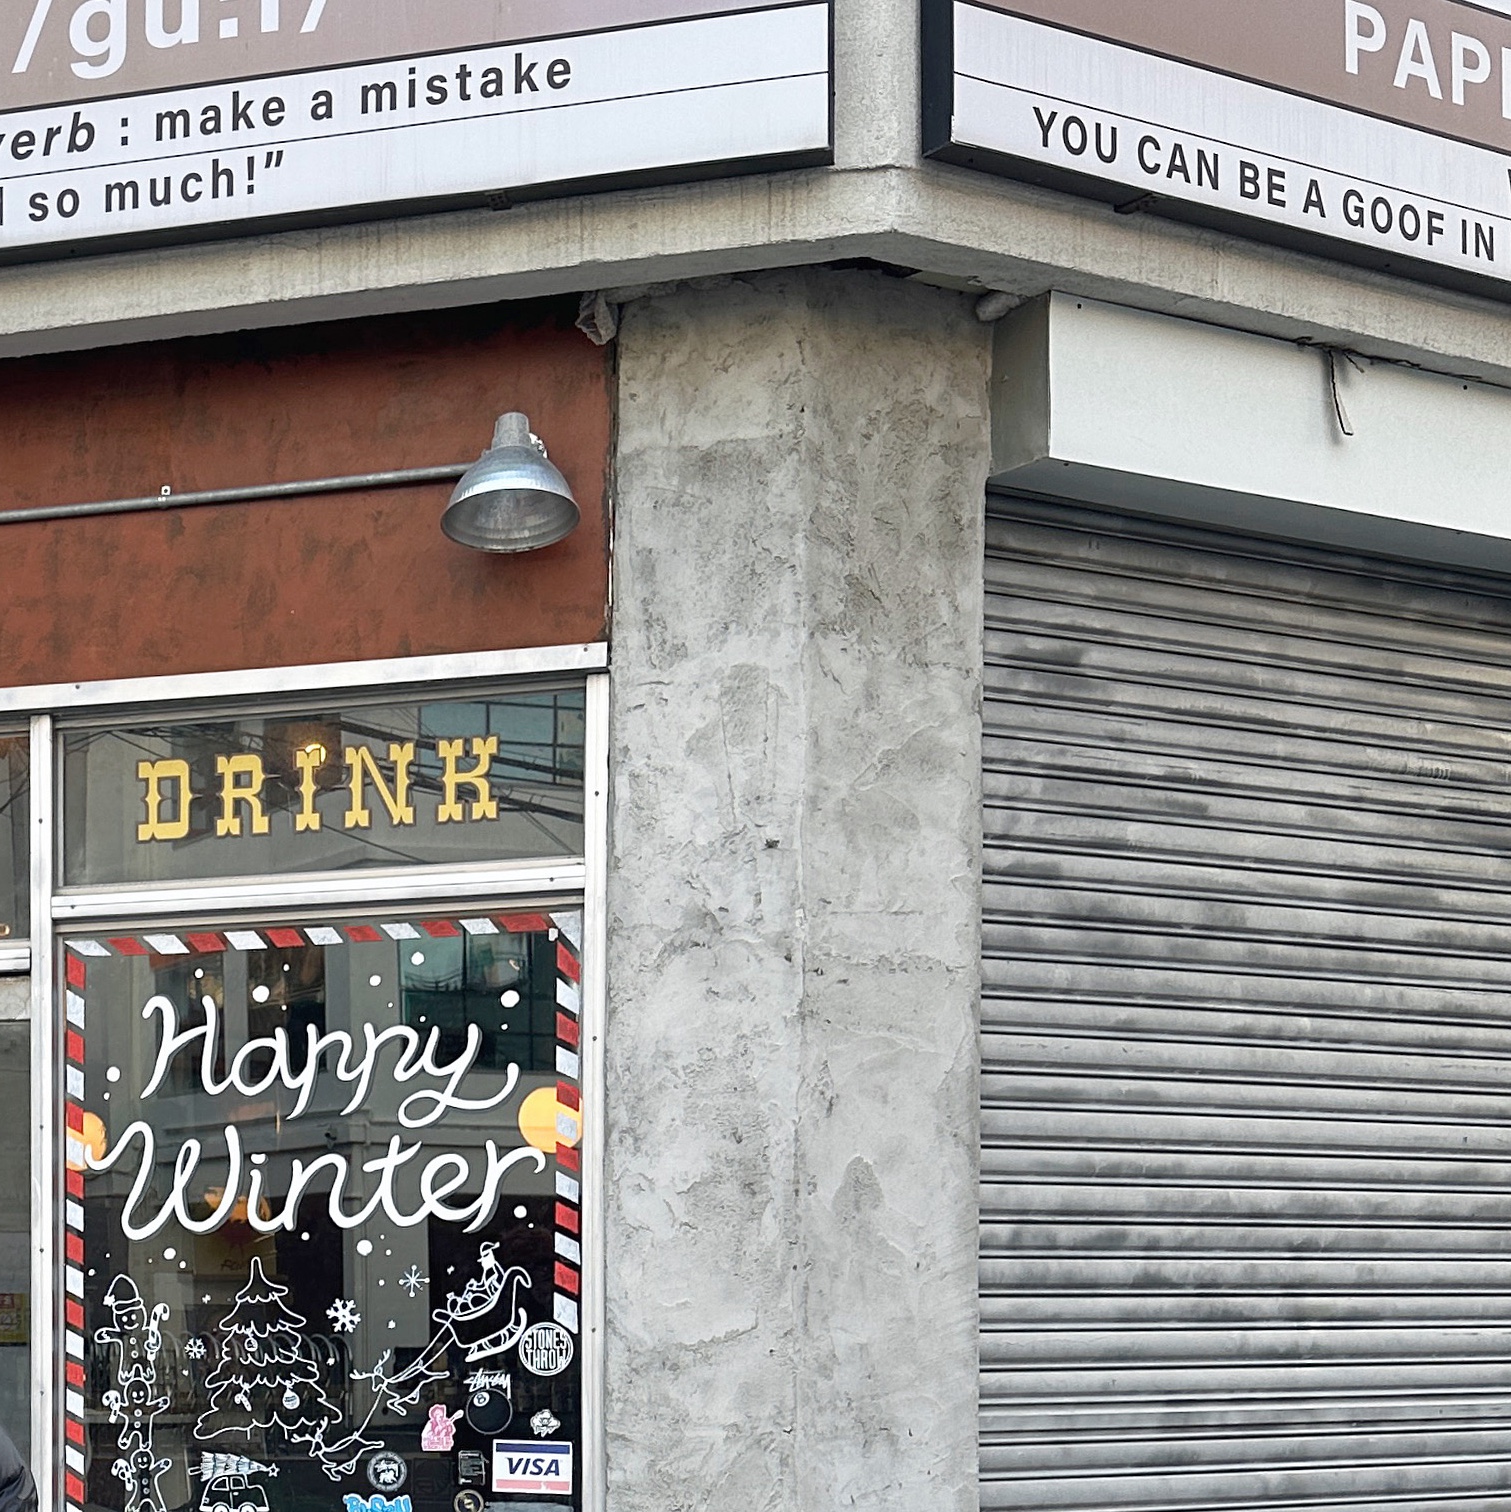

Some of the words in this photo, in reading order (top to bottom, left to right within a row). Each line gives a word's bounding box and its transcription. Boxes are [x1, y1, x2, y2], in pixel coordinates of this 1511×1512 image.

[120, 116, 130, 147] :
[155, 89, 286, 142] make
[310, 83, 334, 121] a
[360, 52, 573, 117] mistake
[28, 184, 79, 225] so
[1033, 106, 1118, 165] YOU
[1137, 135, 1220, 191] CAN
[1239, 160, 1287, 207] BE
[1302, 178, 1327, 219] A
[1343, 188, 1445, 247] GOOF
[1461, 216, 1495, 263] IN
[135, 734, 501, 843] DRINK
[140, 994, 521, 1130] Happy
[84, 1121, 546, 1242] Winter
[524, 1328, 567, 1350] STONES
[525, 1348, 567, 1370] THROW
[506, 1456, 561, 1477] VISA
